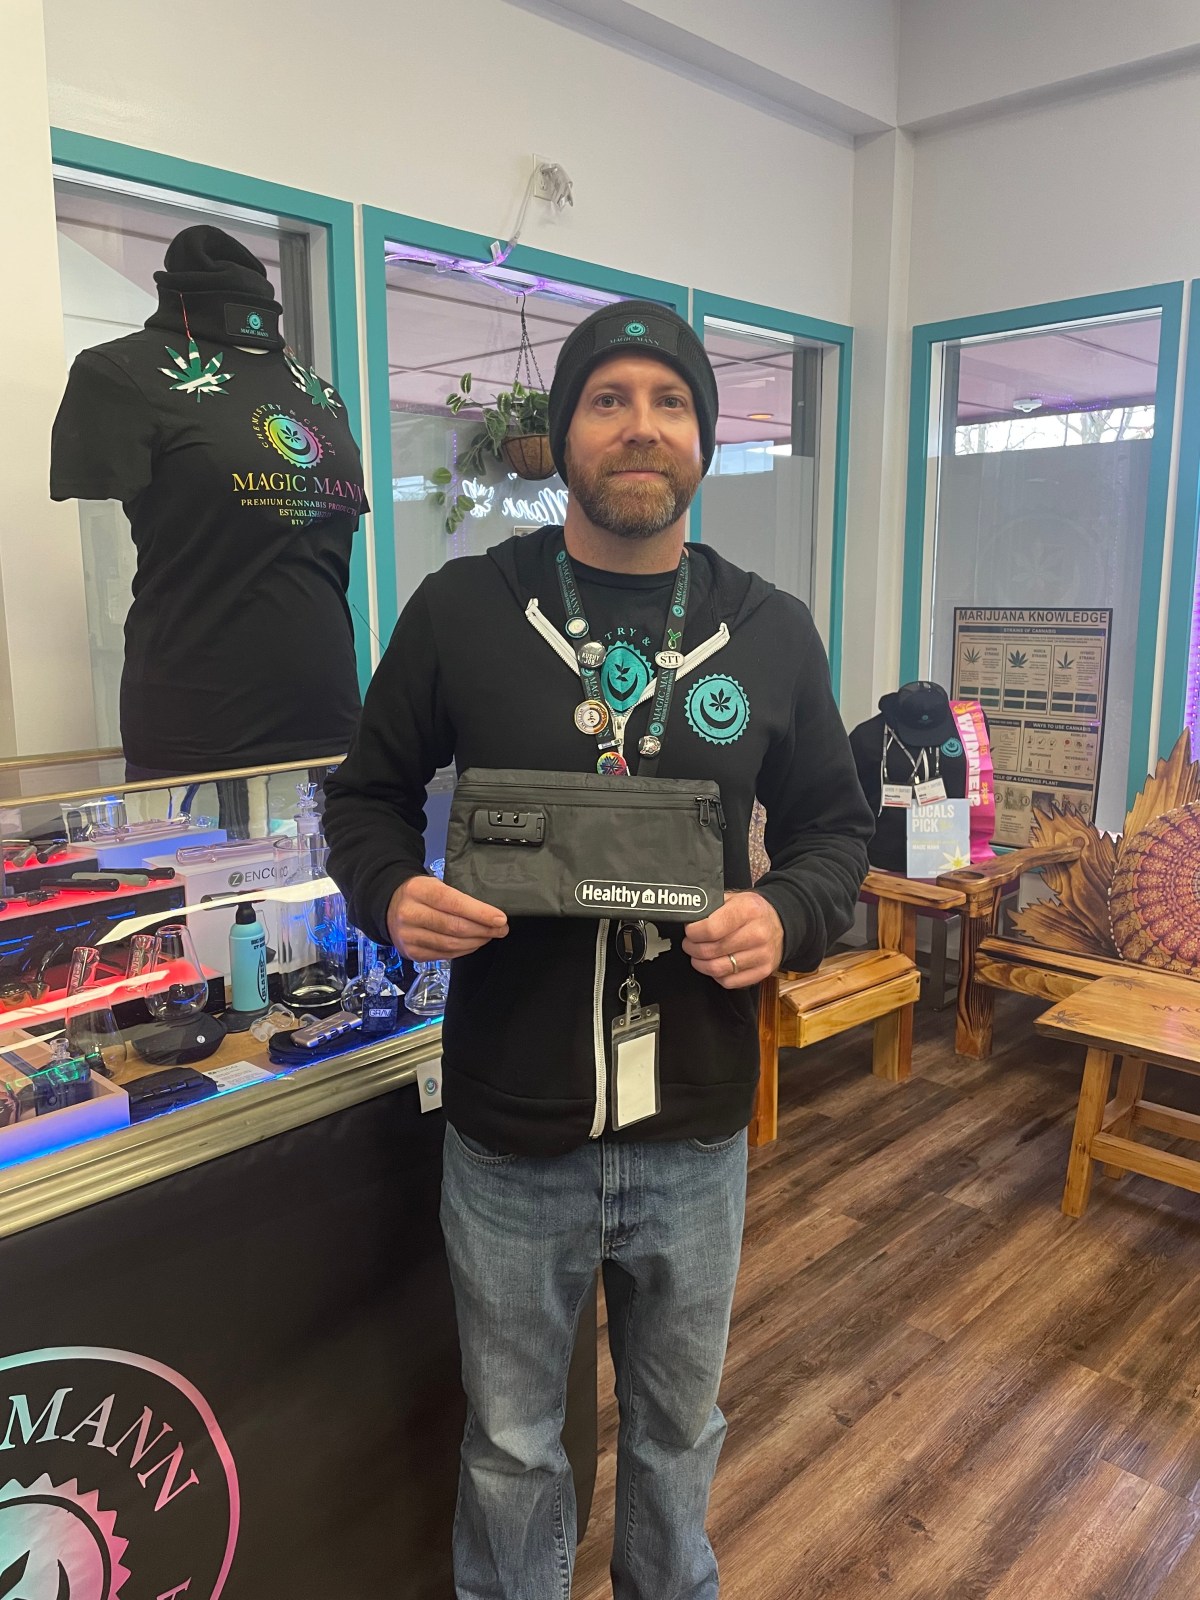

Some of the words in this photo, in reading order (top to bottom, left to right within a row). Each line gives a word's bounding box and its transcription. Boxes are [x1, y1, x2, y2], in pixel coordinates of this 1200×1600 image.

[303, 418, 336, 456] CRAFT
[231, 472, 307, 492] MAGIC
[312, 476, 364, 503] MANN
[240, 498, 283, 507] PREMIUM
[285, 499, 327, 509] CANNABIS
[560, 560, 574, 588] MAGIC
[567, 588, 581, 615] MANN
[959, 610, 1025, 621] MARIJUANA
[1028, 611, 1107, 623] KNOWLEDGE
[604, 627, 637, 641] TRY
[642, 636, 651, 646] &
[660, 655, 681, 664] STT
[652, 690, 666, 722] MAGIC
[957, 713, 981, 807] WINNER
[912, 804, 954, 818] LOCALS
[912, 818, 939, 832] PICK
[582, 884, 640, 907] Healthy
[657, 889, 701, 906] Home
[0, 1387, 200, 1512] MANN
